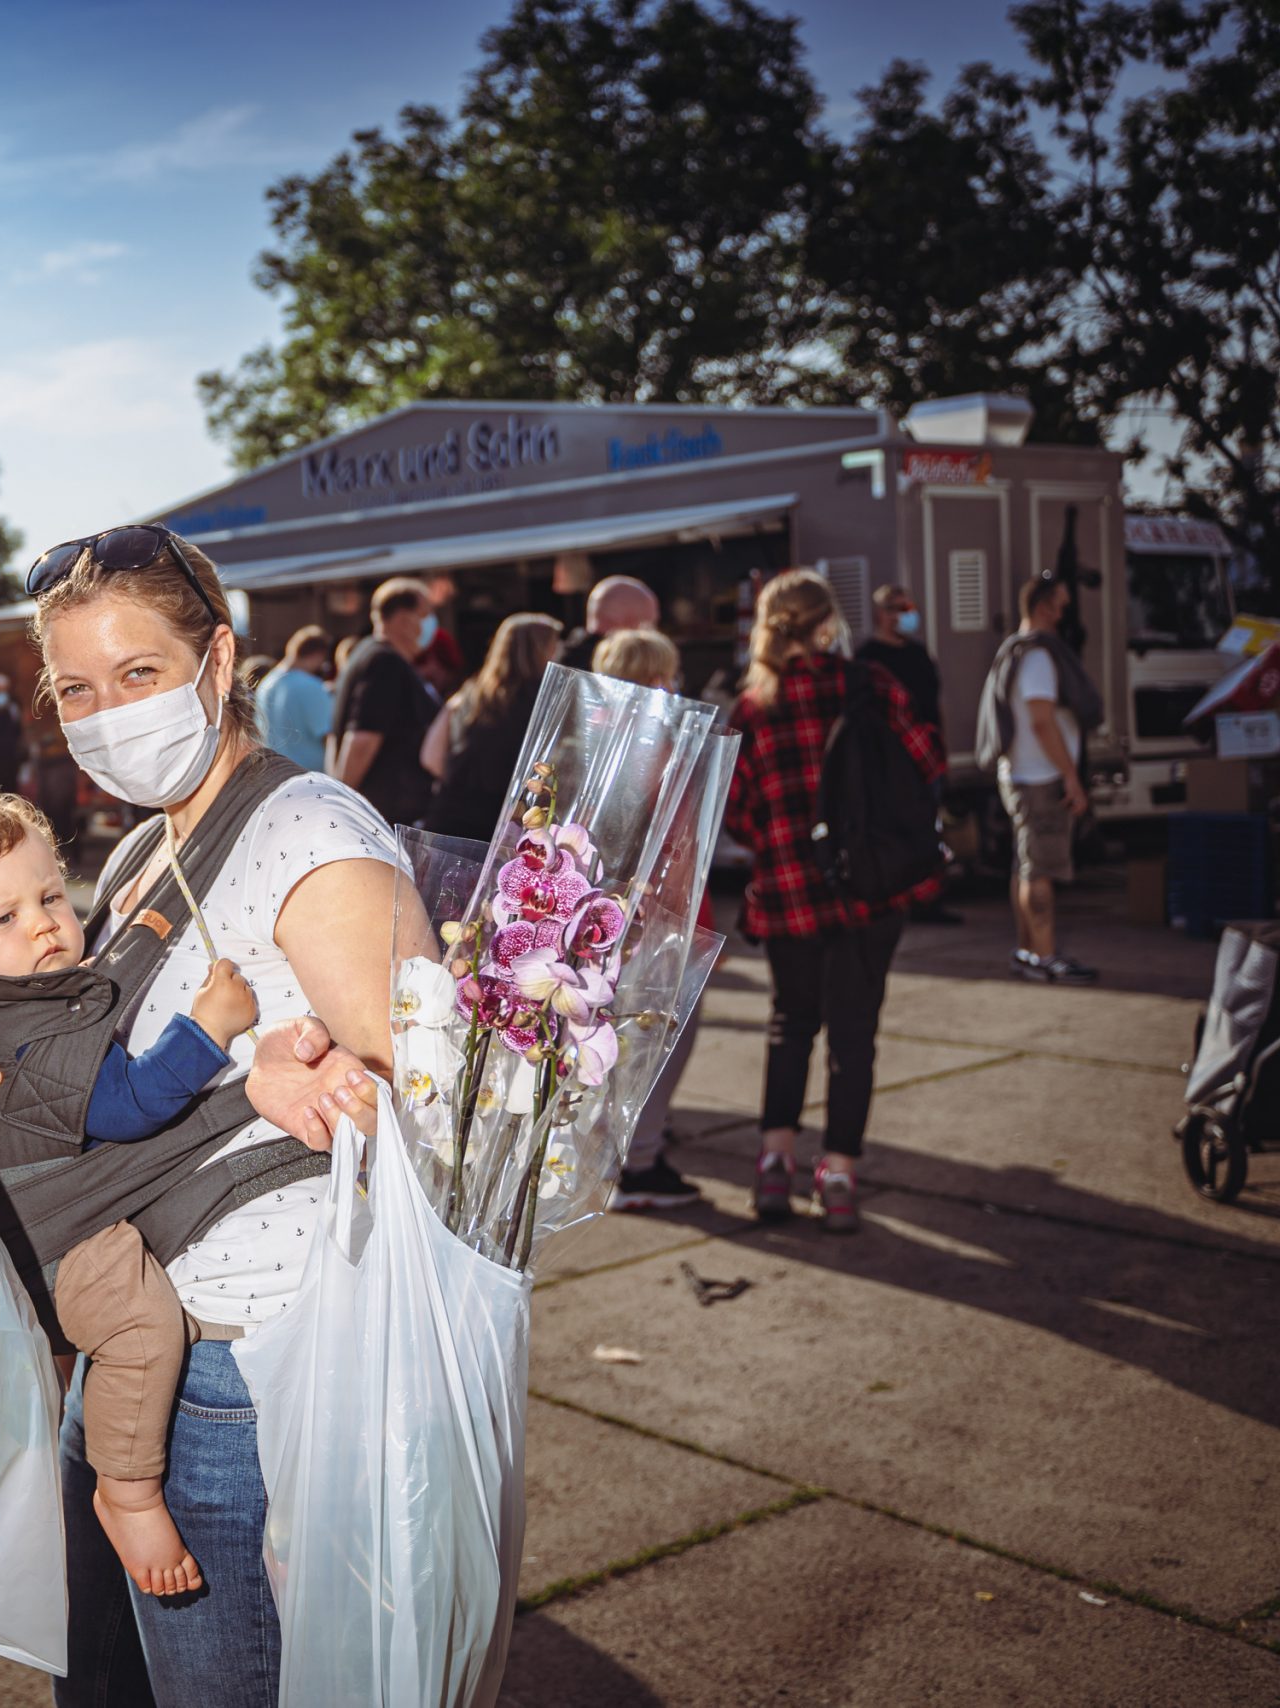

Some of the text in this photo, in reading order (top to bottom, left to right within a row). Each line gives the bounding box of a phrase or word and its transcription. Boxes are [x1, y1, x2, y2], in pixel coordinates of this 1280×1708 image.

[301, 449, 392, 497] Marx
[399, 427, 461, 483] und
[467, 414, 560, 473] Sohn
